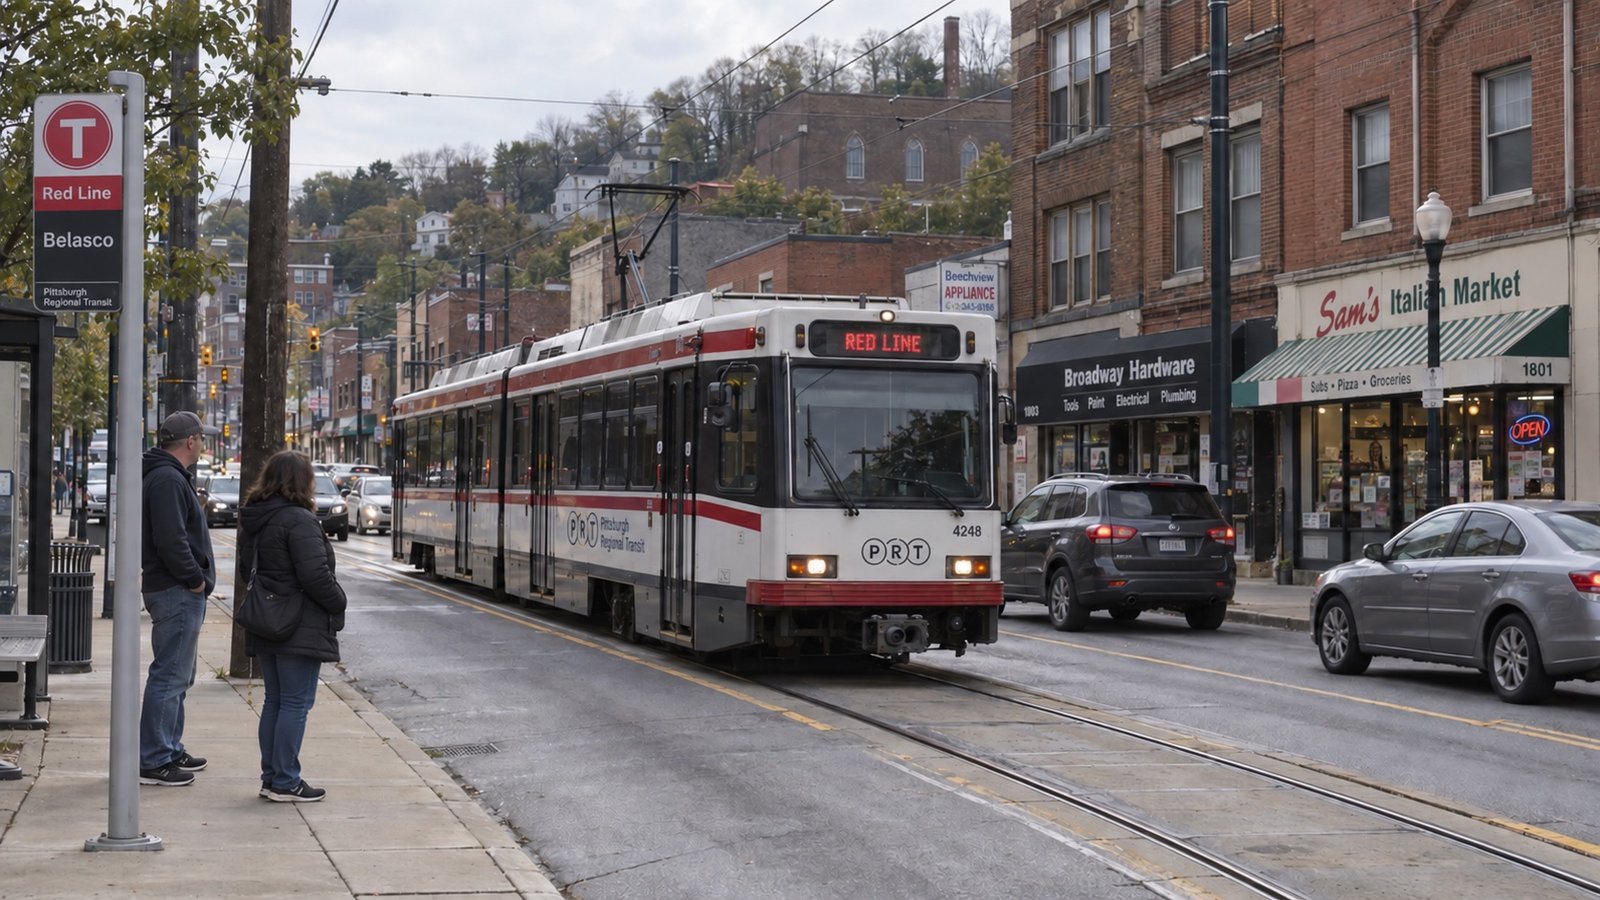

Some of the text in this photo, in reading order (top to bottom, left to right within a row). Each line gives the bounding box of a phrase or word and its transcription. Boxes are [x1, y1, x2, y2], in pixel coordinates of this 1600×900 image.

[60, 118, 96, 159] T
[43, 186, 112, 200] Red Line
[43, 232, 114, 248] Belasco
[945, 270, 995, 281] Beechview
[43, 287, 88, 298] Pittsburgh
[945, 286, 995, 300] APPLIANCE
[43, 297, 113, 308] Regional Transit
[1316, 286, 1380, 338] Sam's
[1454, 269, 1521, 306] Market
[845, 333, 921, 352] RED LINE
[1064, 356, 1196, 388] Broadway Hardware
[1522, 362, 1553, 377] 1801
[1310, 372, 1412, 393] Subs Pizza Groceries
[1064, 389, 1197, 412] Tools Paint Electrical Plumbing
[1512, 420, 1545, 438] OPEN
[953, 525, 982, 537] 4248
